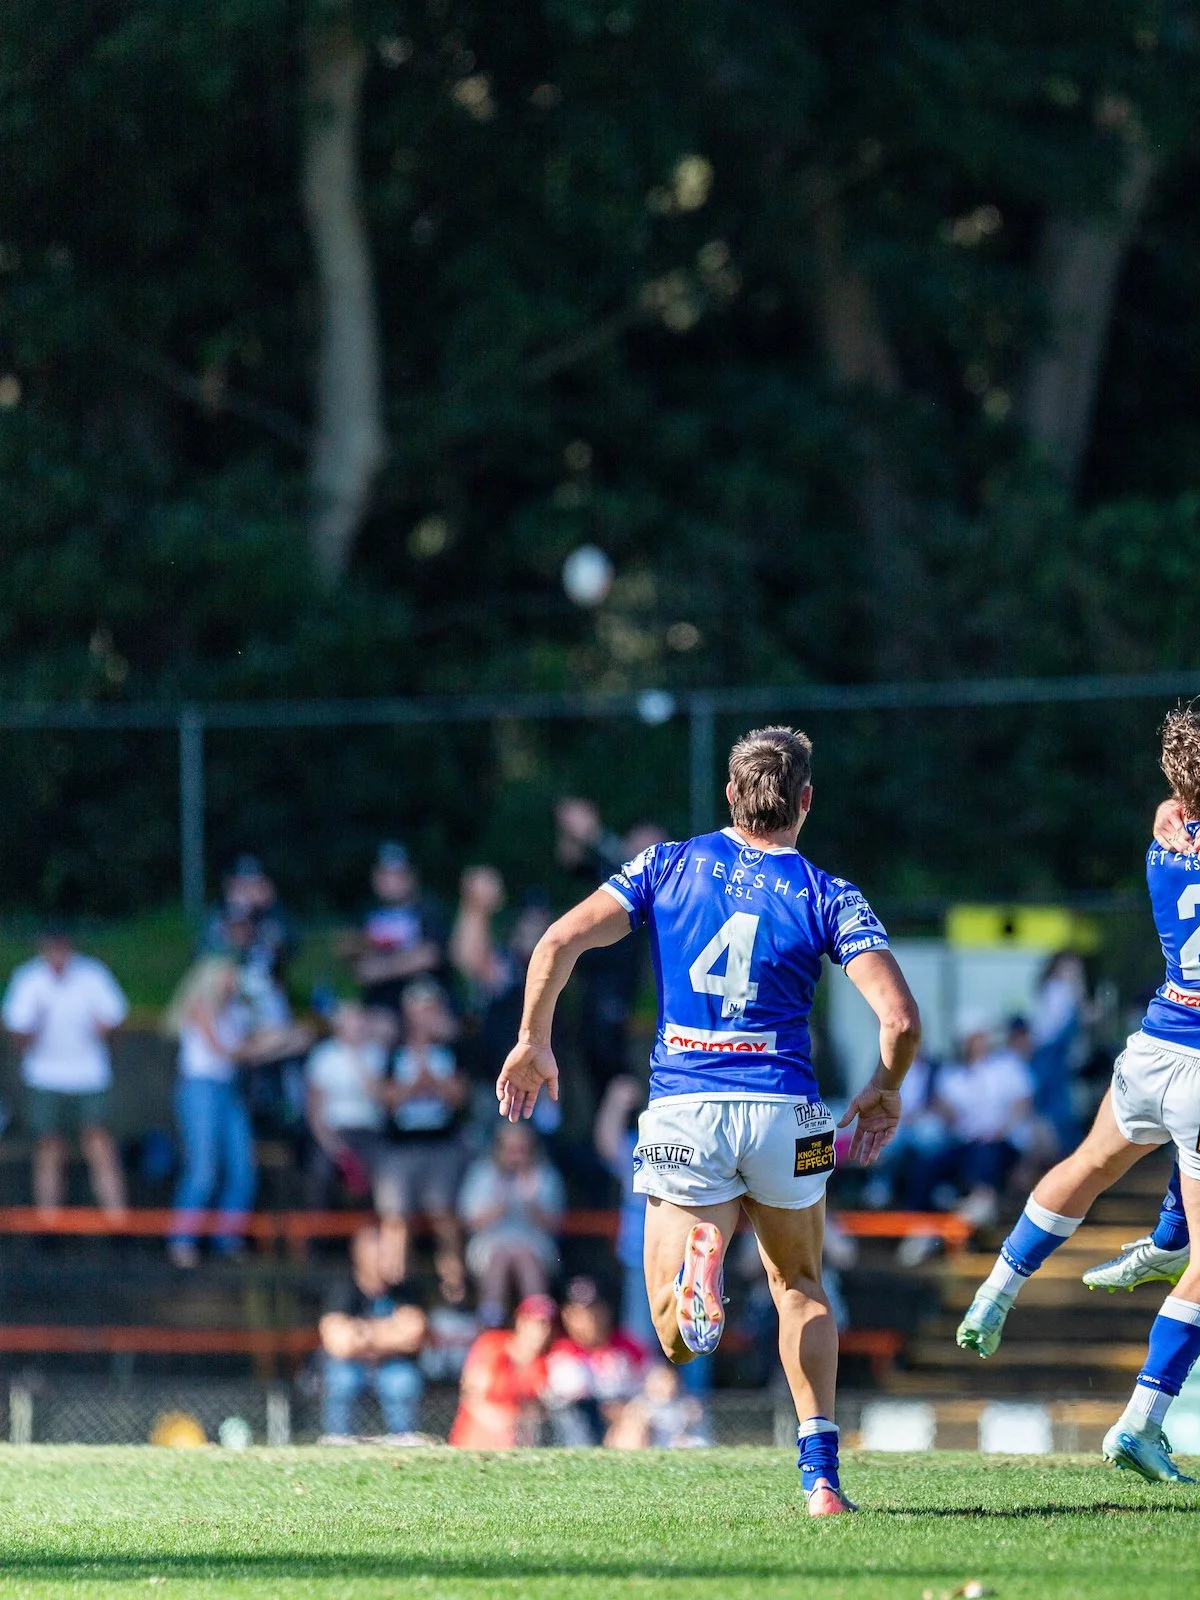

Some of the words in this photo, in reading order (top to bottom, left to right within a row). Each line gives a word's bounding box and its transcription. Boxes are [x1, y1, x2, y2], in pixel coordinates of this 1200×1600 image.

[724, 884, 753, 900] RSL
[689, 911, 760, 1018] 4
[797, 1104, 815, 1121] THE
[811, 1141, 822, 1149] THE
[664, 1146, 690, 1163] VIC
[797, 1152, 833, 1171] EFFECT
